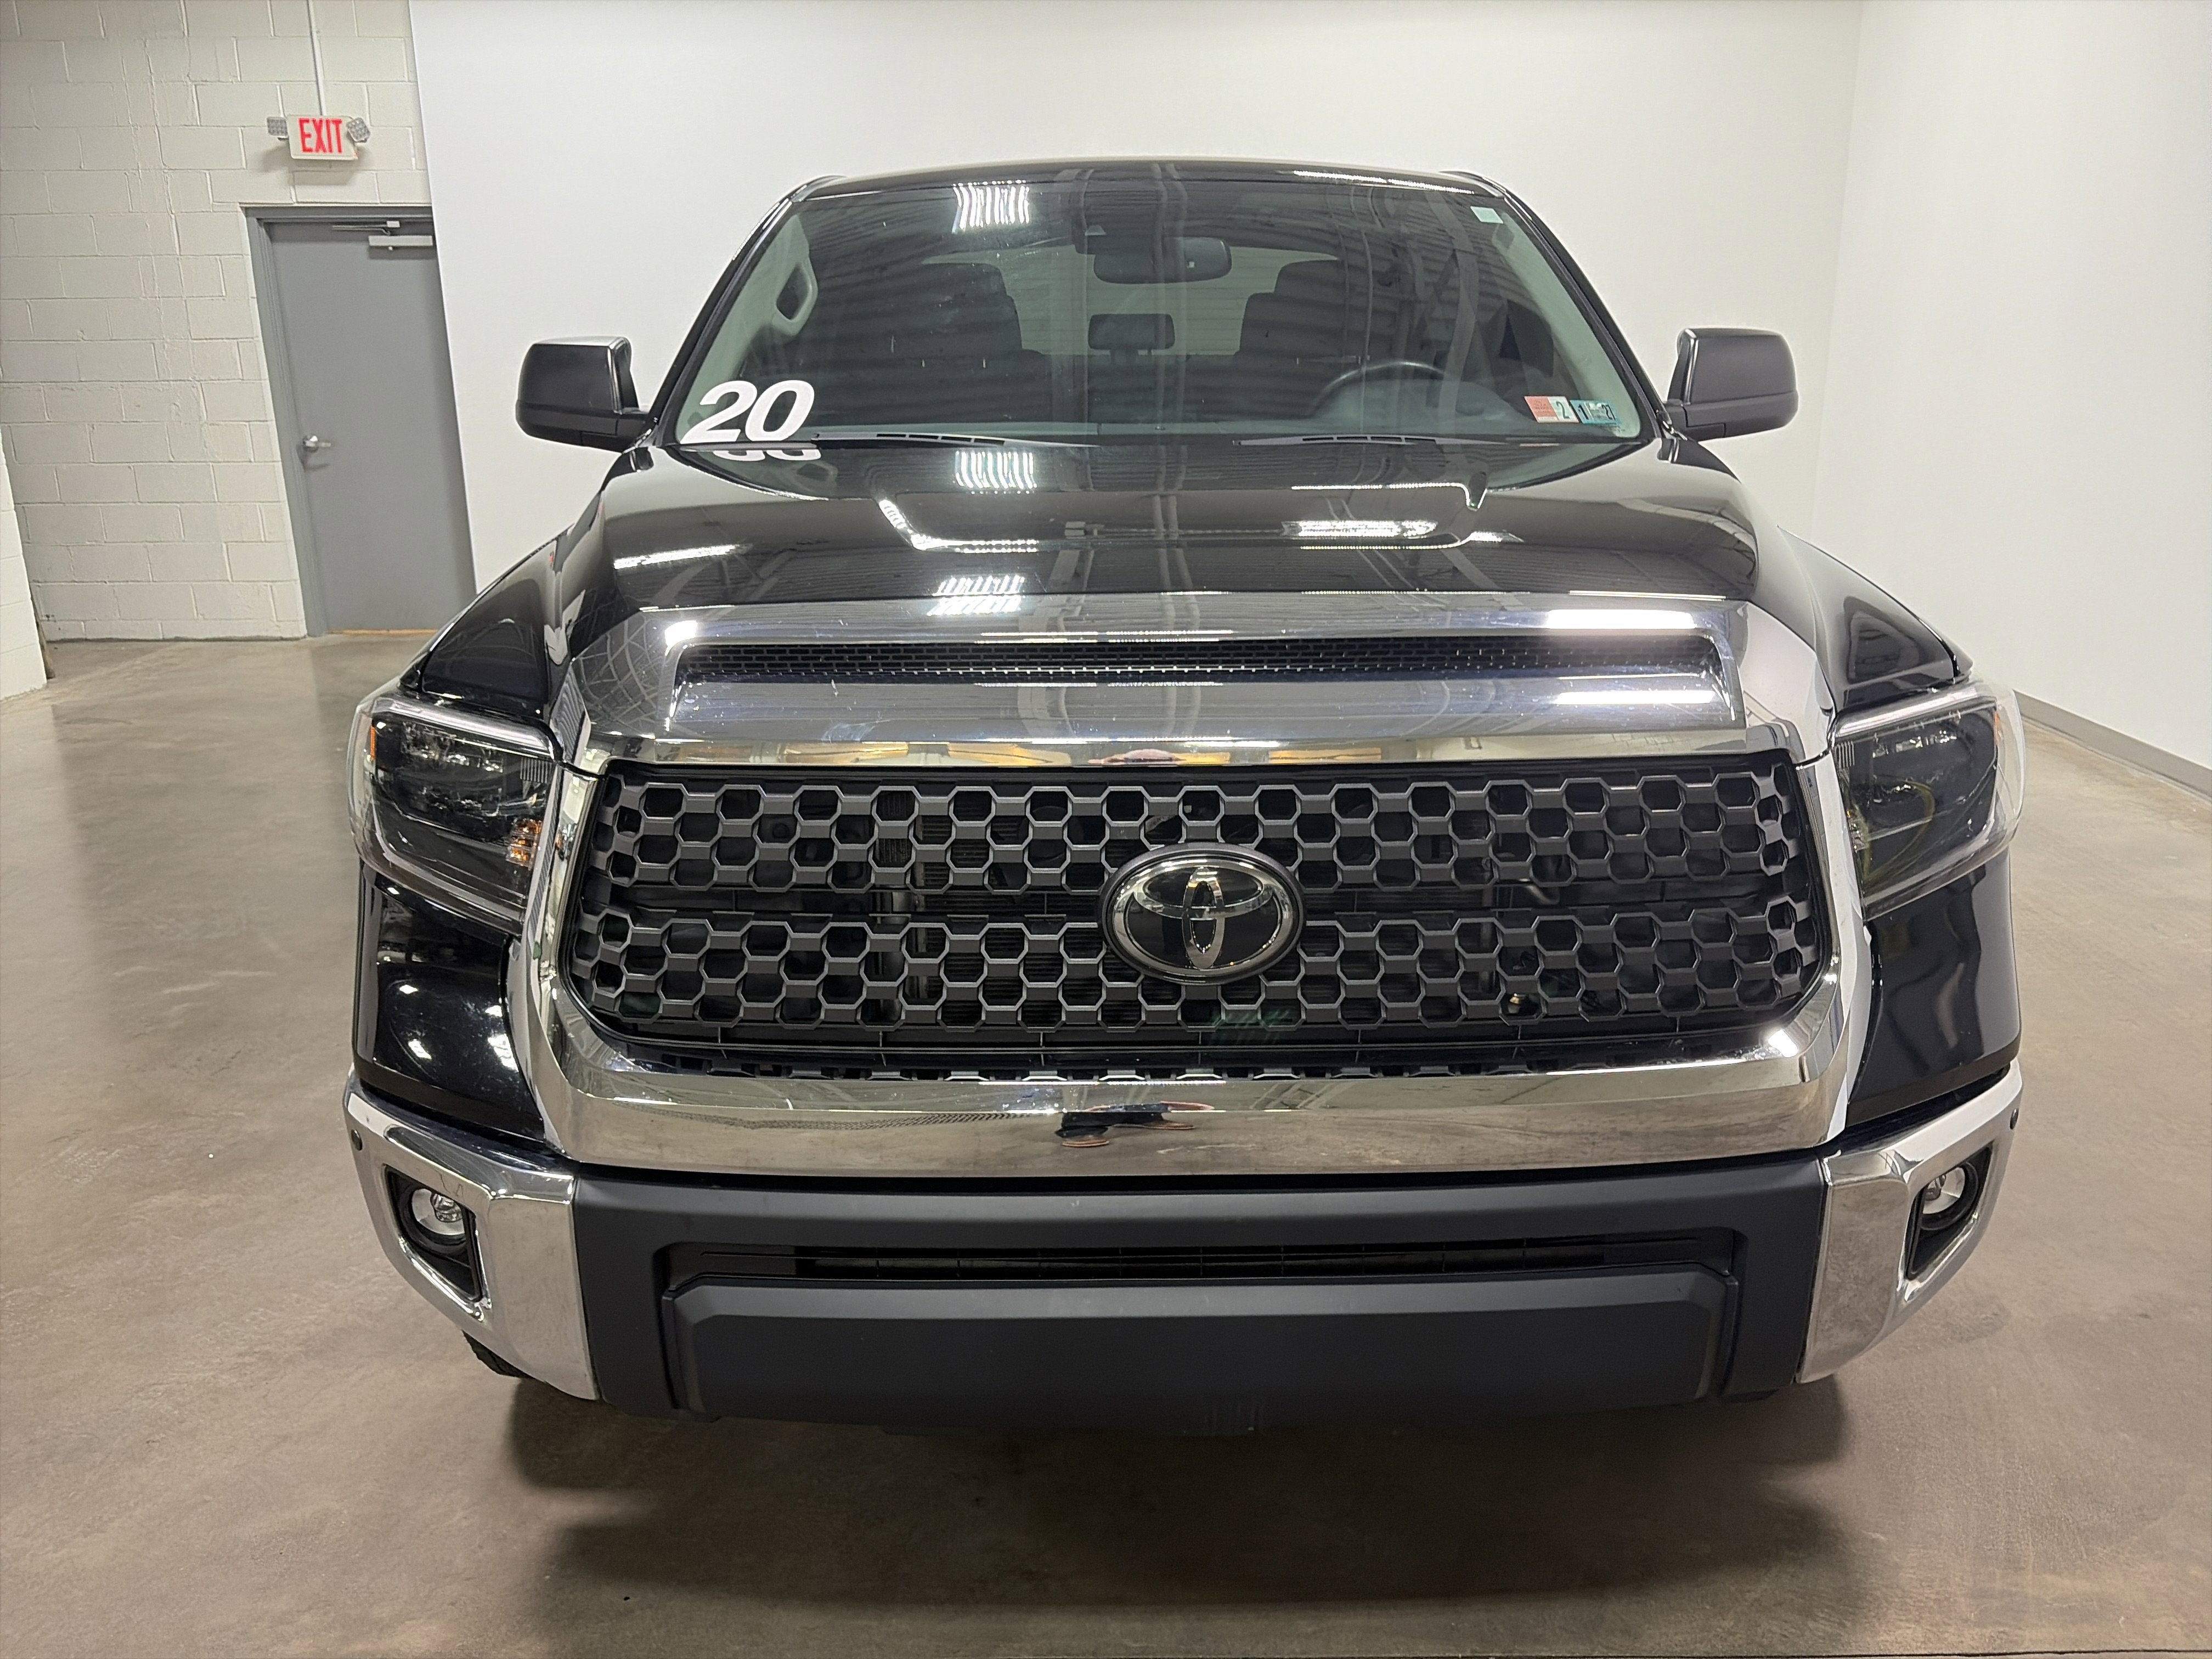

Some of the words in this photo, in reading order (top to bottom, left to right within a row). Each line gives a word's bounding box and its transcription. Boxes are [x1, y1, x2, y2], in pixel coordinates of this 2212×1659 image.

[298, 117, 343, 154] EXIT
[680, 380, 815, 444] 20
[1556, 401, 1571, 419] 2
